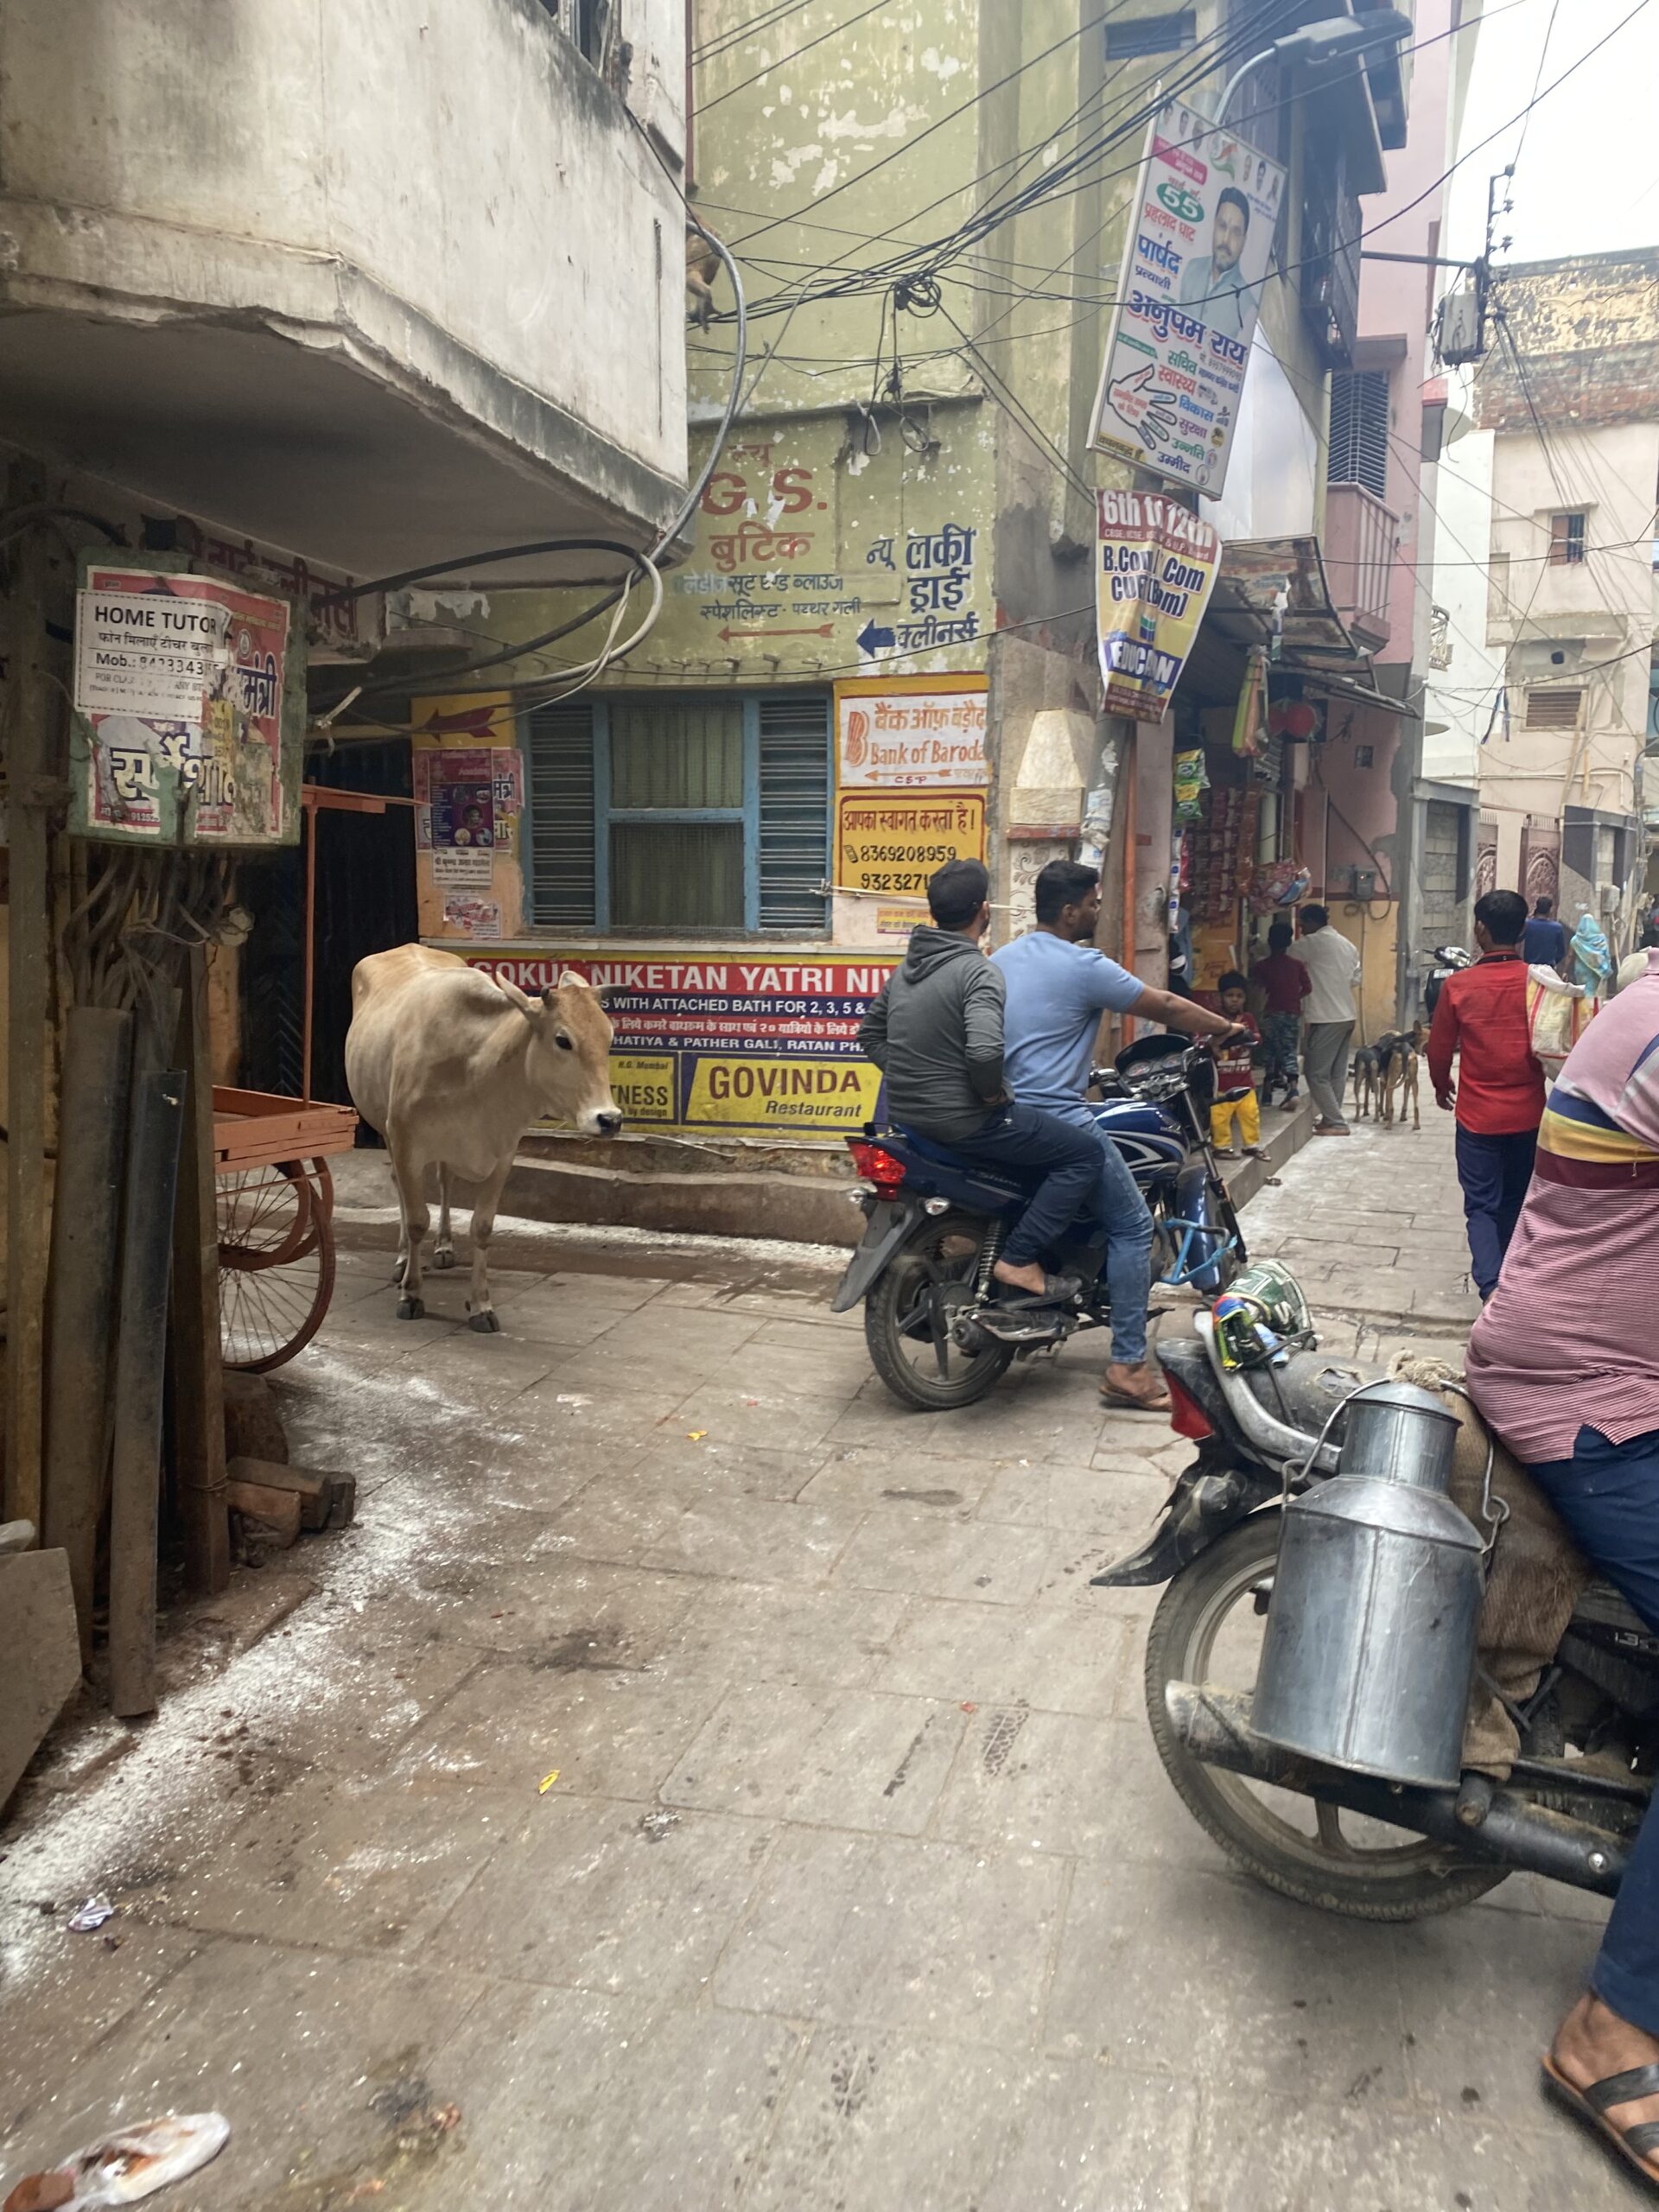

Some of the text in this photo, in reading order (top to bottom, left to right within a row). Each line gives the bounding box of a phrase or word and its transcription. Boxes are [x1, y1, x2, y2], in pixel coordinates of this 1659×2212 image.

[1163, 185, 1198, 219] 55
[1139, 234, 1182, 275] पार्षद
[1135, 265, 1171, 290] प्रत्याशी
[1127, 289, 1207, 346] अनुपम
[1210, 329, 1248, 365] राय
[1167, 350, 1198, 375] सचिव
[1158, 365, 1198, 397] स्वास्थ्य
[1179, 394, 1214, 422] विकास
[1179, 417, 1208, 439] सुरक्षा
[1171, 436, 1205, 461] उन्नति
[1157, 451, 1192, 474] उम्मीद
[1103, 490, 1141, 527] 6th
[709, 520, 815, 573] बुटिक
[866, 523, 976, 570] न्यू लकी
[728, 574, 757, 596] सूट
[1162, 556, 1205, 592] Com
[907, 567, 970, 613] ड्राई
[832, 596, 861, 614] गली
[95, 606, 156, 627] HOME
[162, 612, 216, 635] TUTOR
[897, 611, 980, 648] क्लीनर्स
[98, 632, 121, 644] फोन
[160, 635, 188, 651] टीचर
[874, 700, 910, 730] बैंक
[871, 742, 909, 766] Bank
[911, 740, 931, 764] of
[843, 810, 876, 831] आपका
[878, 810, 918, 832] स्वागत
[920, 809, 954, 832] करता
[860, 844, 957, 862] 8369208959
[861, 873, 930, 891] 9323271
[589, 963, 727, 990] NIKETAN
[740, 966, 833, 993] YATRI
[613, 997, 649, 1009] WITH
[652, 998, 728, 1011] ATTACHED
[732, 999, 772, 1013] BATH
[775, 1001, 807, 1014] FOR
[842, 1001, 852, 1014] 5
[855, 1002, 867, 1014] &
[613, 1036, 664, 1046] HATIYA
[668, 1038, 678, 1047] &
[683, 1038, 740, 1048] PATHER
[787, 1039, 835, 1051] RATAN
[636, 1061, 669, 1070] Mumbai
[709, 1065, 861, 1100] GOVINDA
[610, 1085, 668, 1106] TNESS
[766, 1101, 862, 1117] Restaurant
